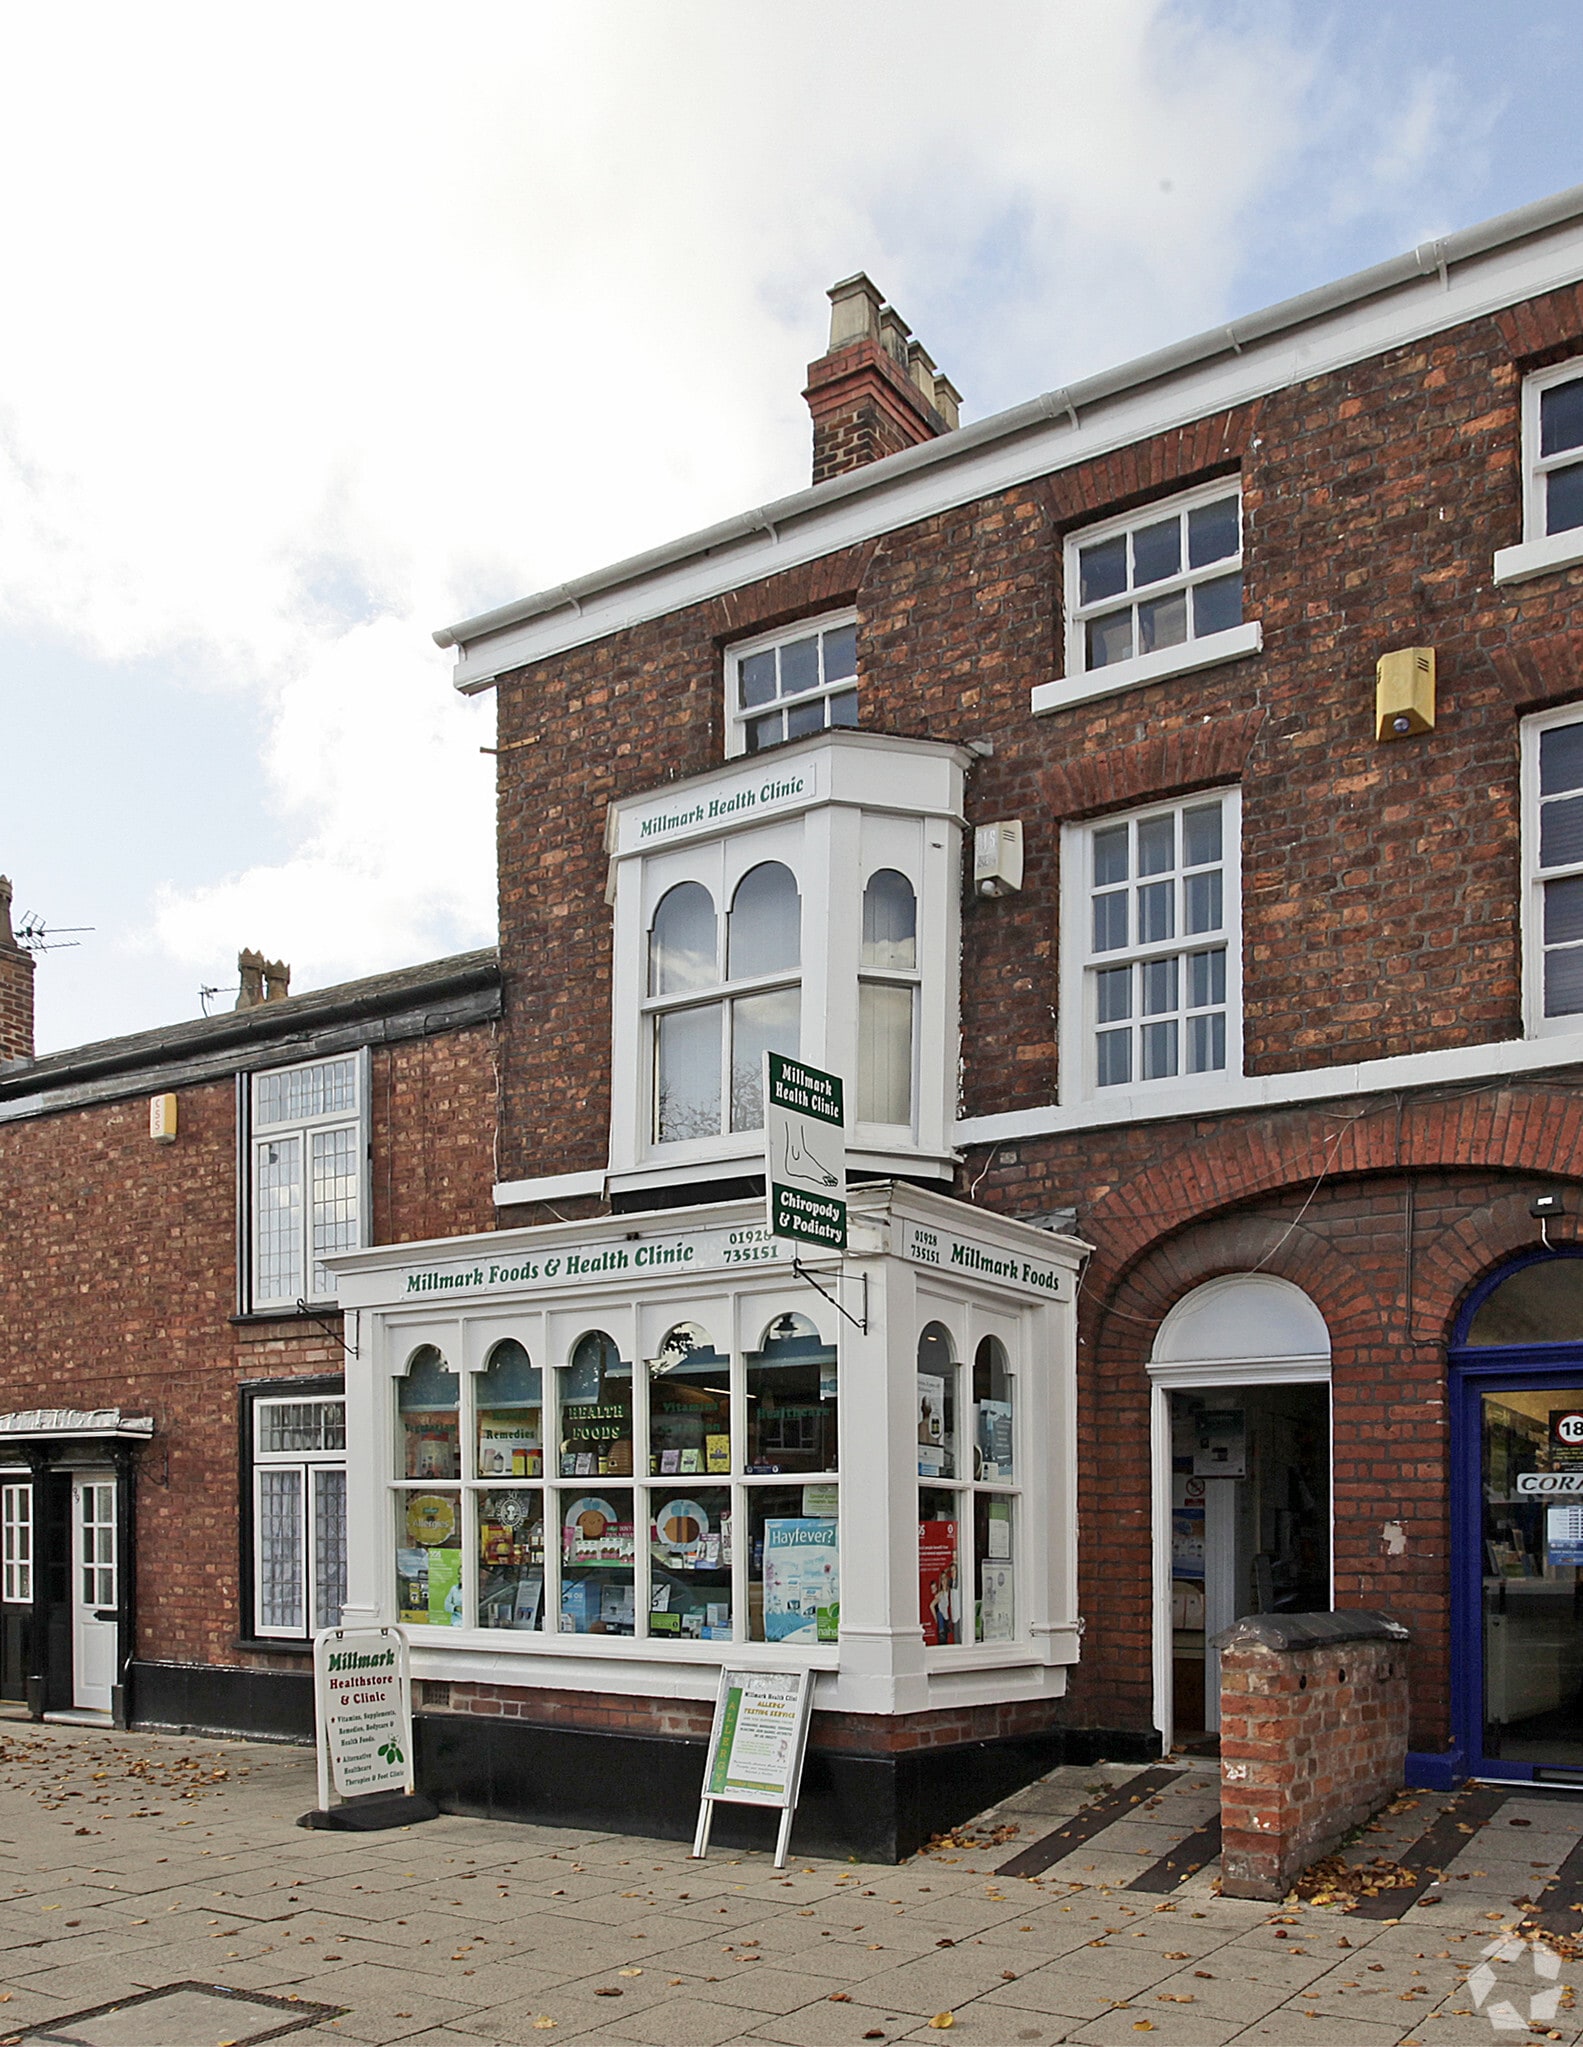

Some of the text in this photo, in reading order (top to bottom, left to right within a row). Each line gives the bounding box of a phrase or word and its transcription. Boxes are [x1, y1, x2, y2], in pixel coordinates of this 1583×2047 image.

[640, 776, 805, 838] Millmark Health Clinic
[781, 1063, 832, 1097] Millmark
[775, 1081, 839, 1118] Health Clinic
[780, 1191, 840, 1222] Chiropody
[779, 1211, 842, 1244] & Podiatry
[729, 1229, 771, 1245] 01928
[914, 1230, 937, 1247] 01928
[723, 1244, 779, 1263] 735151
[911, 1244, 940, 1264] 735151
[406, 1241, 694, 1293] Millmark Foods & Health Clinic
[950, 1243, 1059, 1291] Millmark Foods
[568, 1405, 624, 1419] HEALTH
[663, 1402, 719, 1412] Vitamins
[757, 1407, 830, 1419] Healthcare
[486, 1429, 535, 1440] Remedies
[572, 1426, 620, 1440] FOODS
[772, 1528, 834, 1547] Hayfever?
[328, 1649, 395, 1672] Millmark
[329, 1675, 393, 1690] Healthstore
[340, 1691, 386, 1705] & Clinic
[341, 1738, 358, 1746] Health
[343, 1753, 372, 1763] Alternative
[344, 1765, 372, 1774] Healthcare
[345, 1776, 370, 1786] Therapies
[389, 1770, 404, 1778] Clinic
